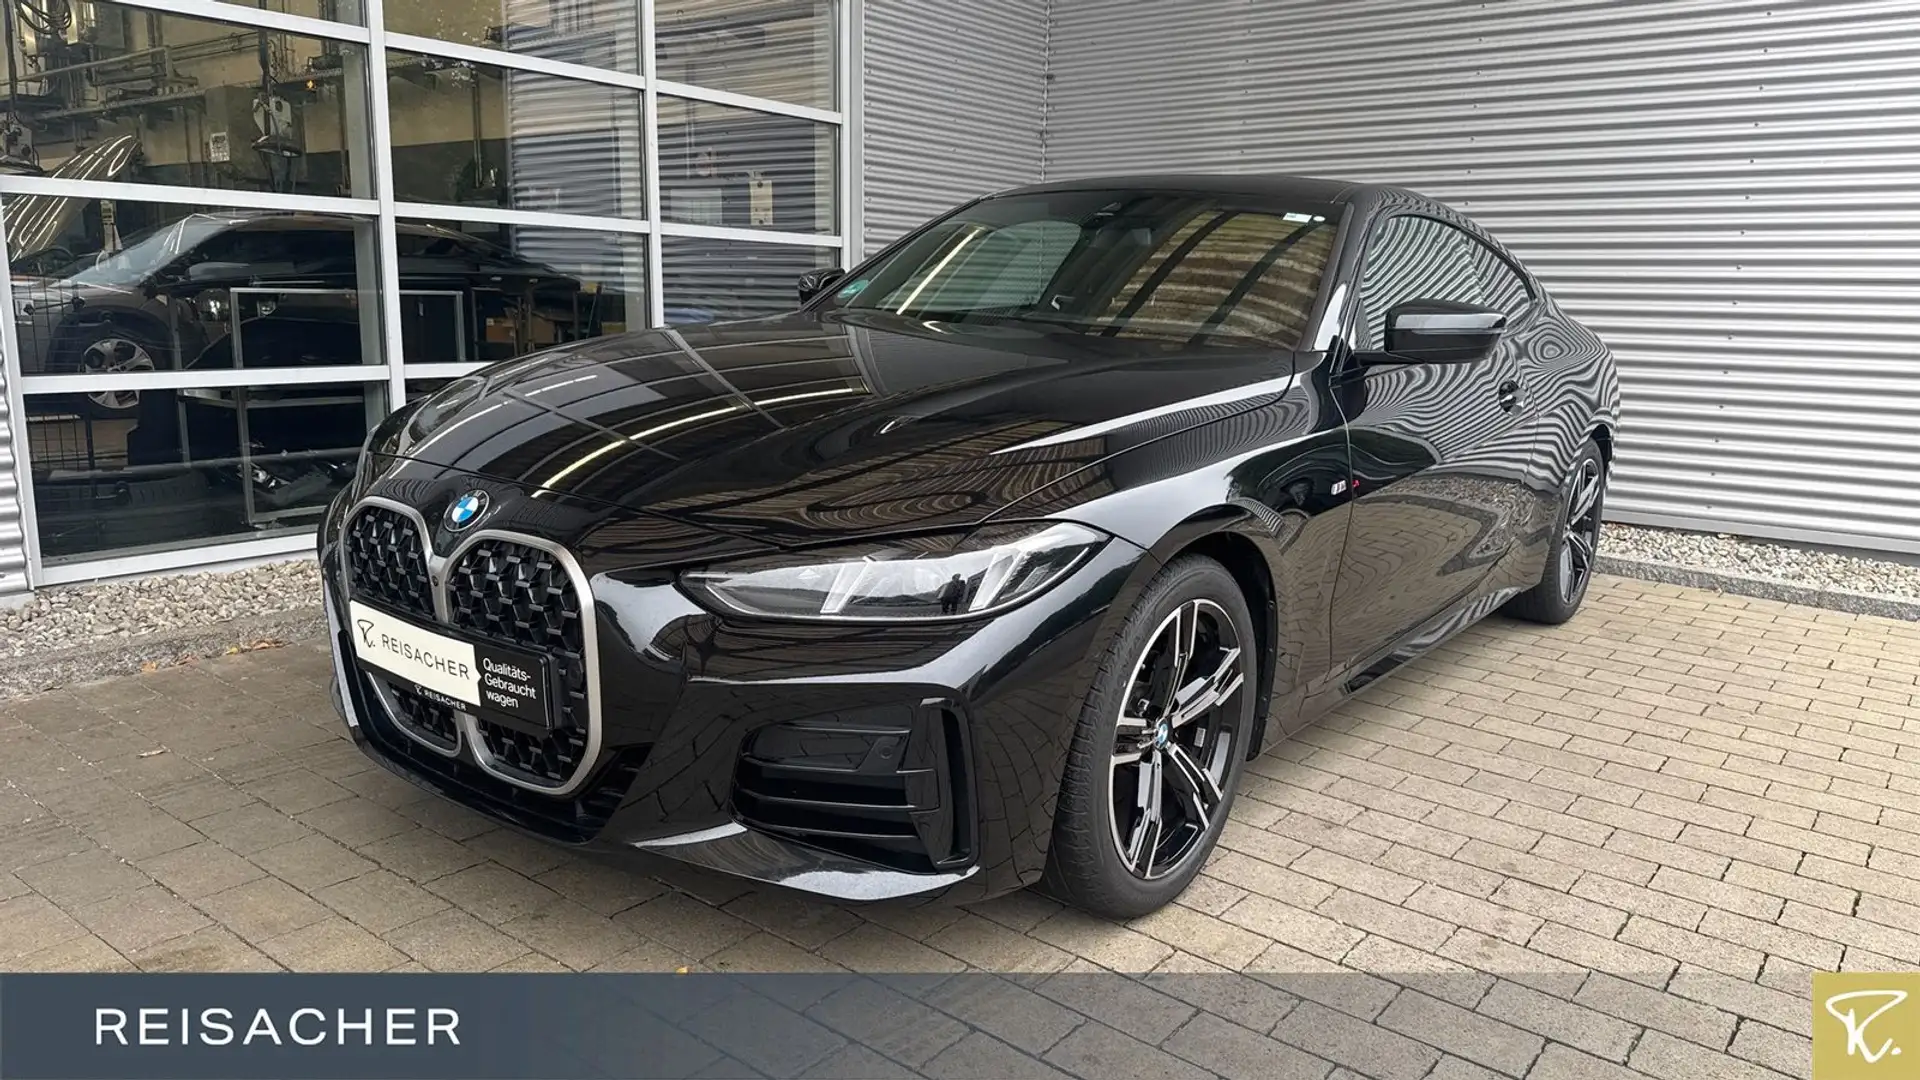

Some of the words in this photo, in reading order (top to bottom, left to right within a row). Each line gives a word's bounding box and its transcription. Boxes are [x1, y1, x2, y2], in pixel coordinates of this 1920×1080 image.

[381, 633, 470, 680] REISACHER
[482, 657, 532, 682] Qualitäts-
[484, 672, 537, 700] Gebraucht
[424, 689, 467, 711] REISACHER
[485, 690, 519, 709] wagen
